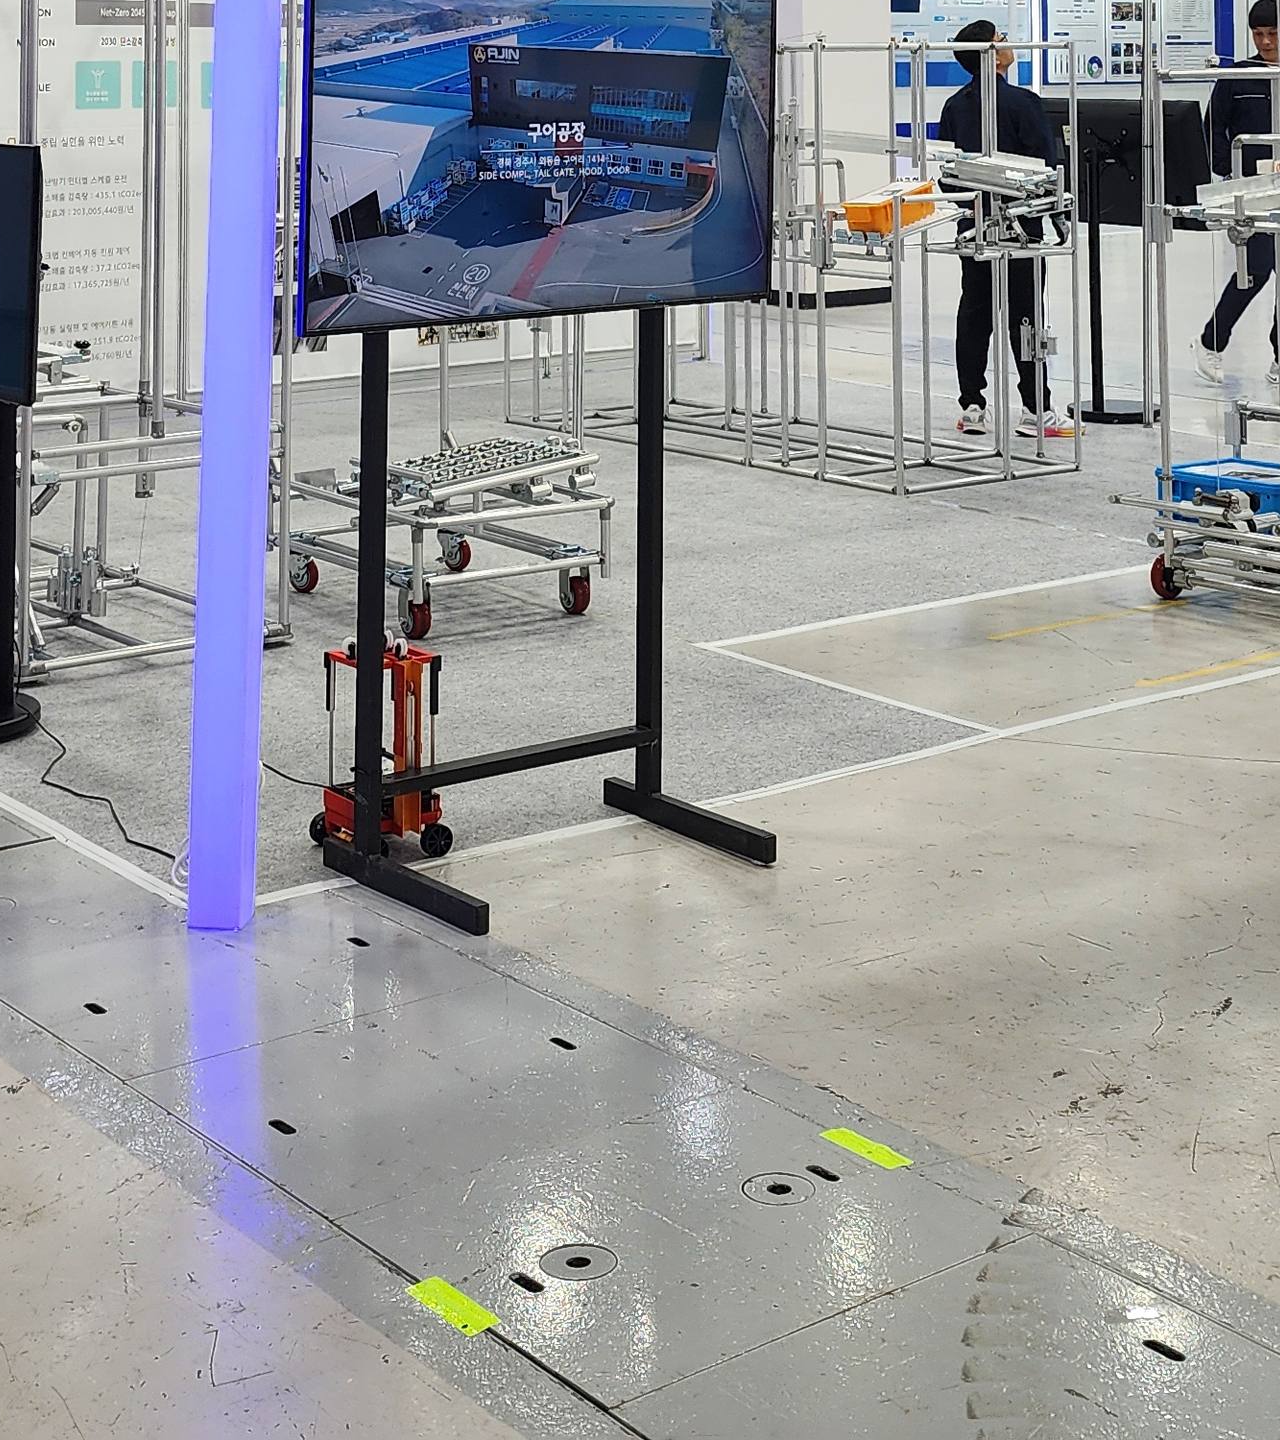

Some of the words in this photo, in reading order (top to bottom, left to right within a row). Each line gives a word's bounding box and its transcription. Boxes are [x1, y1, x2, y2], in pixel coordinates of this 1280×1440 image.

[487, 47, 520, 60] AJIN
[527, 121, 586, 143] 구어공장
[478, 170, 498, 181] SIDE
[534, 168, 550, 178] TAIL
[607, 165, 631, 175] DOOR
[466, 267, 487, 281] 20
